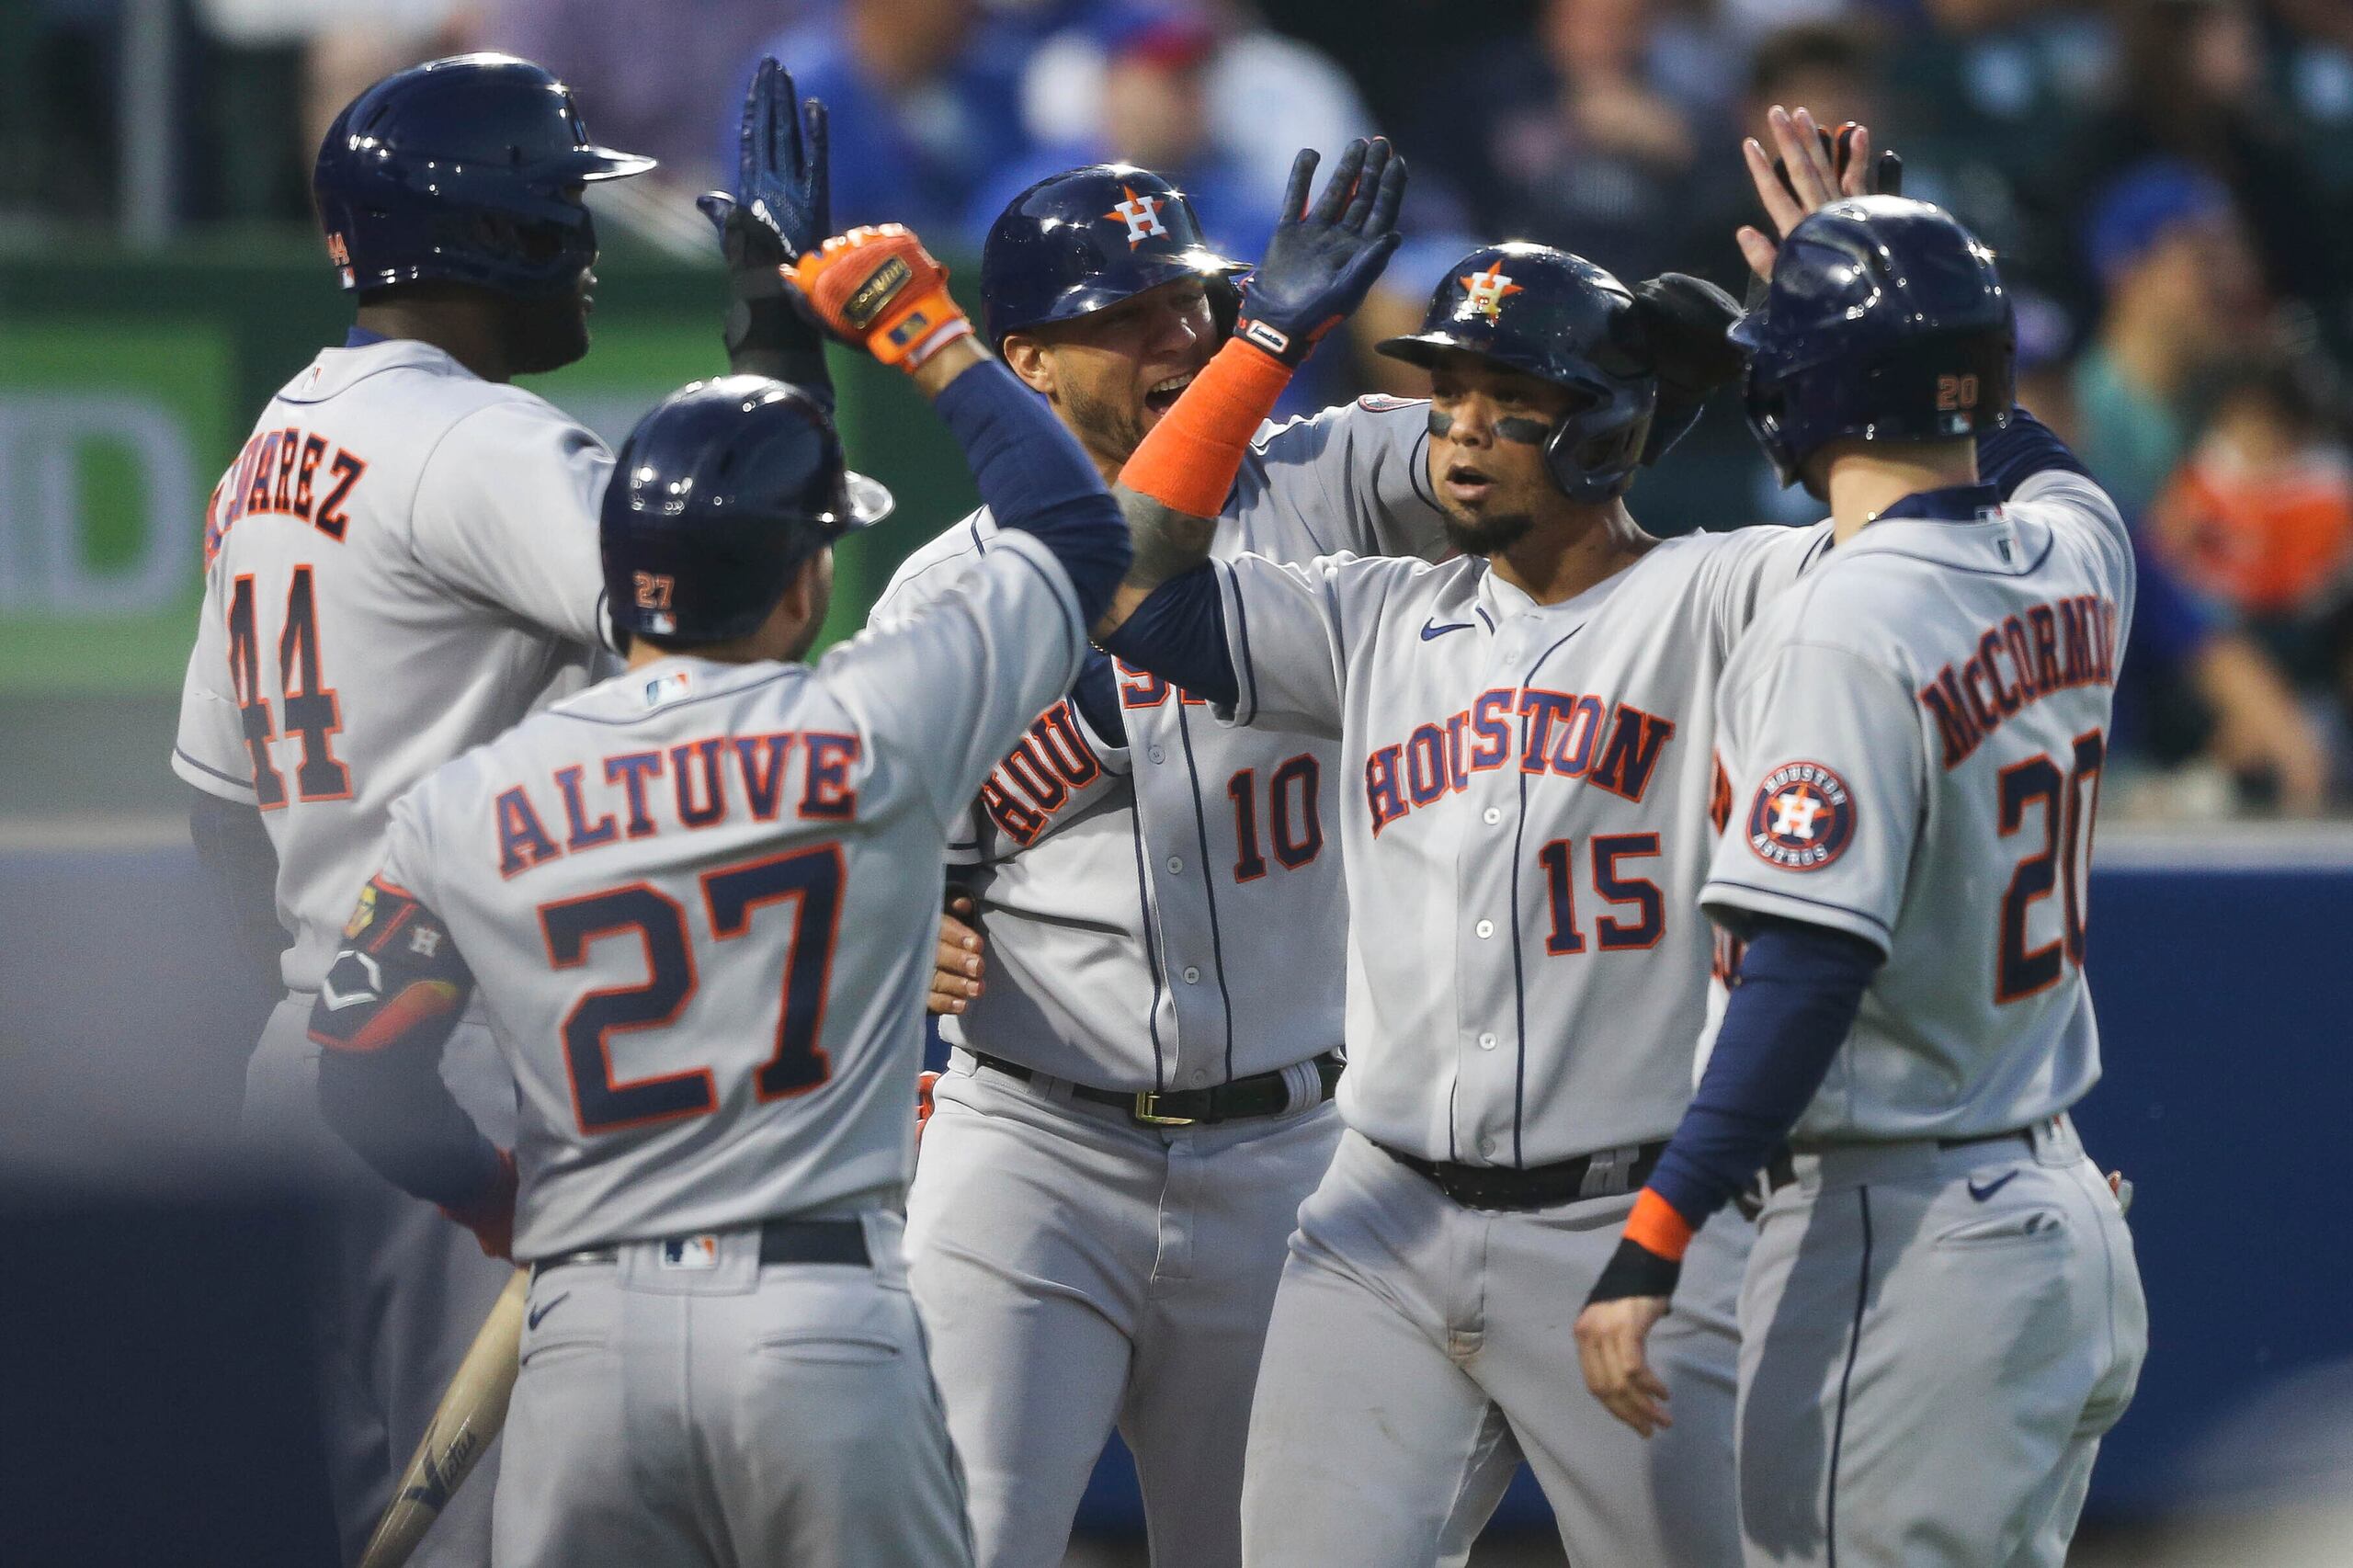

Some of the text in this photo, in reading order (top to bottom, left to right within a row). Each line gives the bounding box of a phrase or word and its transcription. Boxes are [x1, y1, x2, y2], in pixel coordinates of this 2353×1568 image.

[1113, 196, 1168, 243] H
[1466, 271, 1512, 314] H
[1937, 374, 1979, 411] 20
[632, 570, 676, 610] 27
[226, 563, 354, 812] 44
[494, 732, 862, 881] ALTUVE
[1226, 752, 1324, 884] 10
[1365, 687, 1676, 840] HOUSTON
[1770, 792, 1821, 839] H
[1539, 832, 1666, 957] 15
[1995, 727, 2103, 1006] 20
[537, 840, 847, 1137] 27
